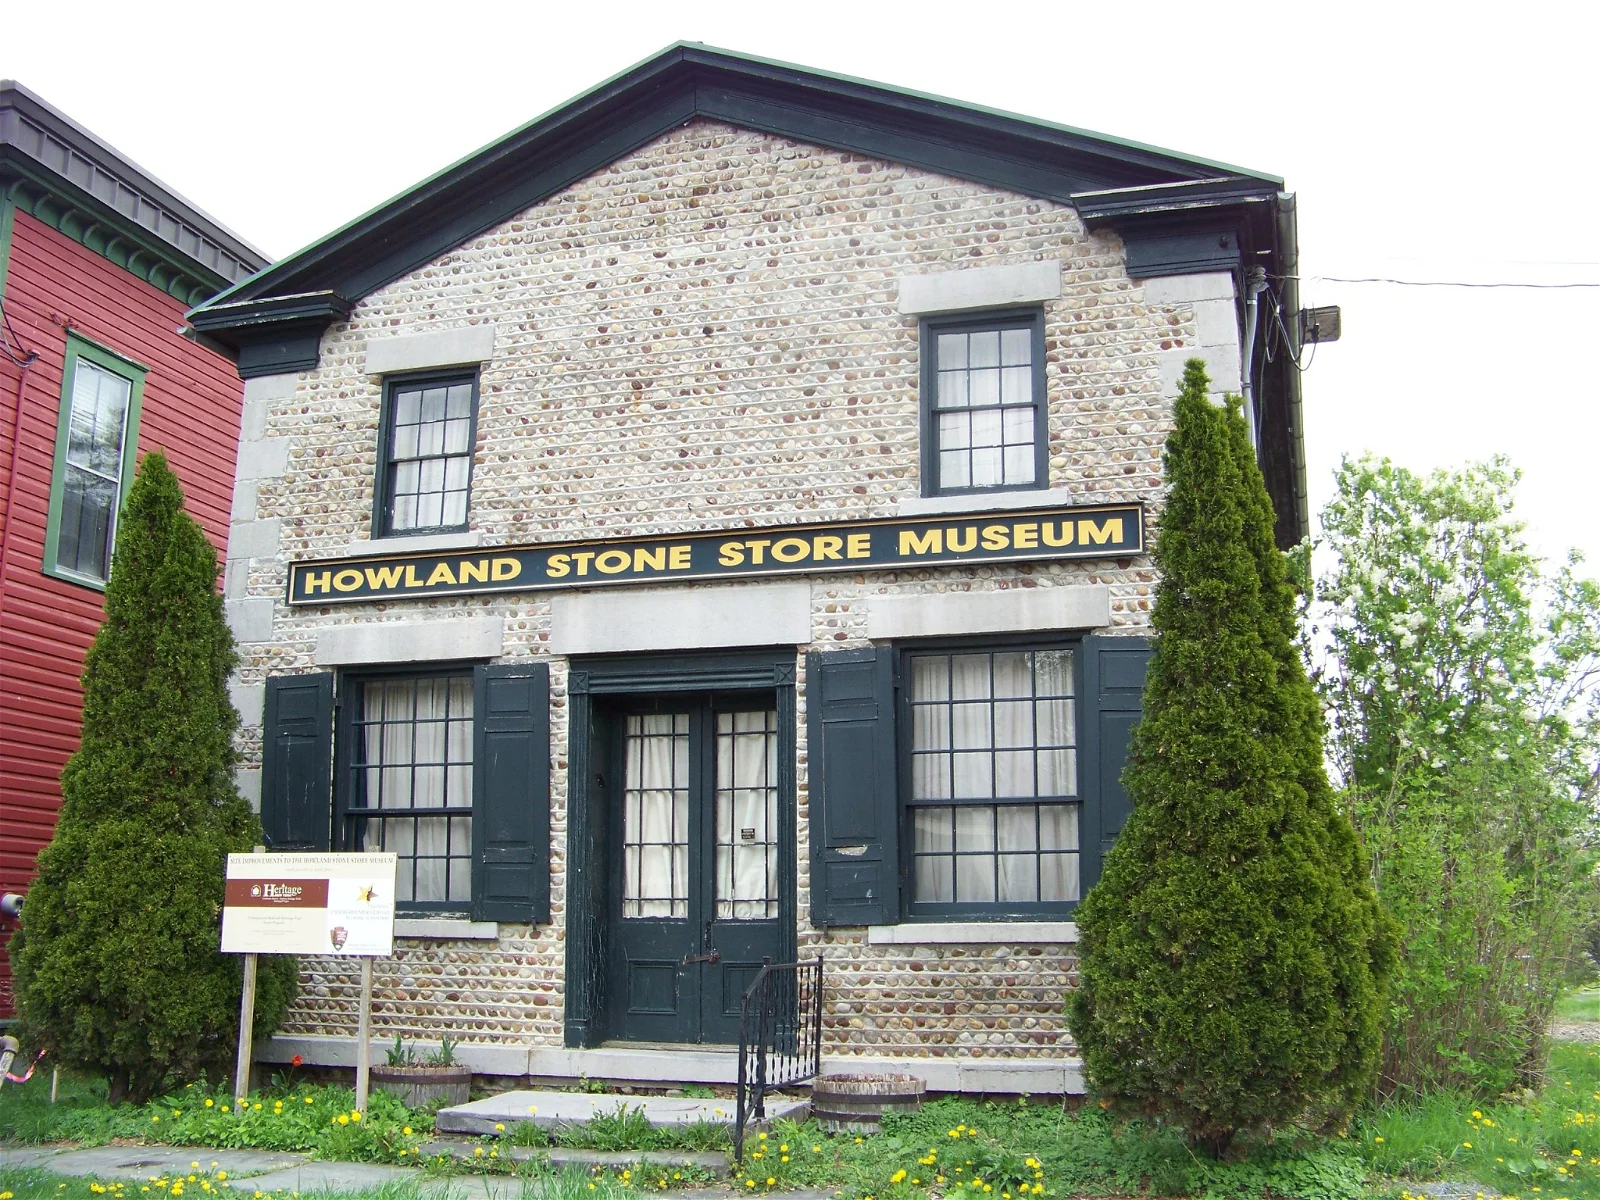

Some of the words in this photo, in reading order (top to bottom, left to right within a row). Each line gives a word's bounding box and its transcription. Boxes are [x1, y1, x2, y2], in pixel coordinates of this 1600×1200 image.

[304, 557, 522, 594] HOWLAND
[546, 545, 691, 577] STONE
[718, 533, 870, 567] STORE
[899, 518, 1123, 555] MUSEUM
[263, 883, 302, 897] Heritage
